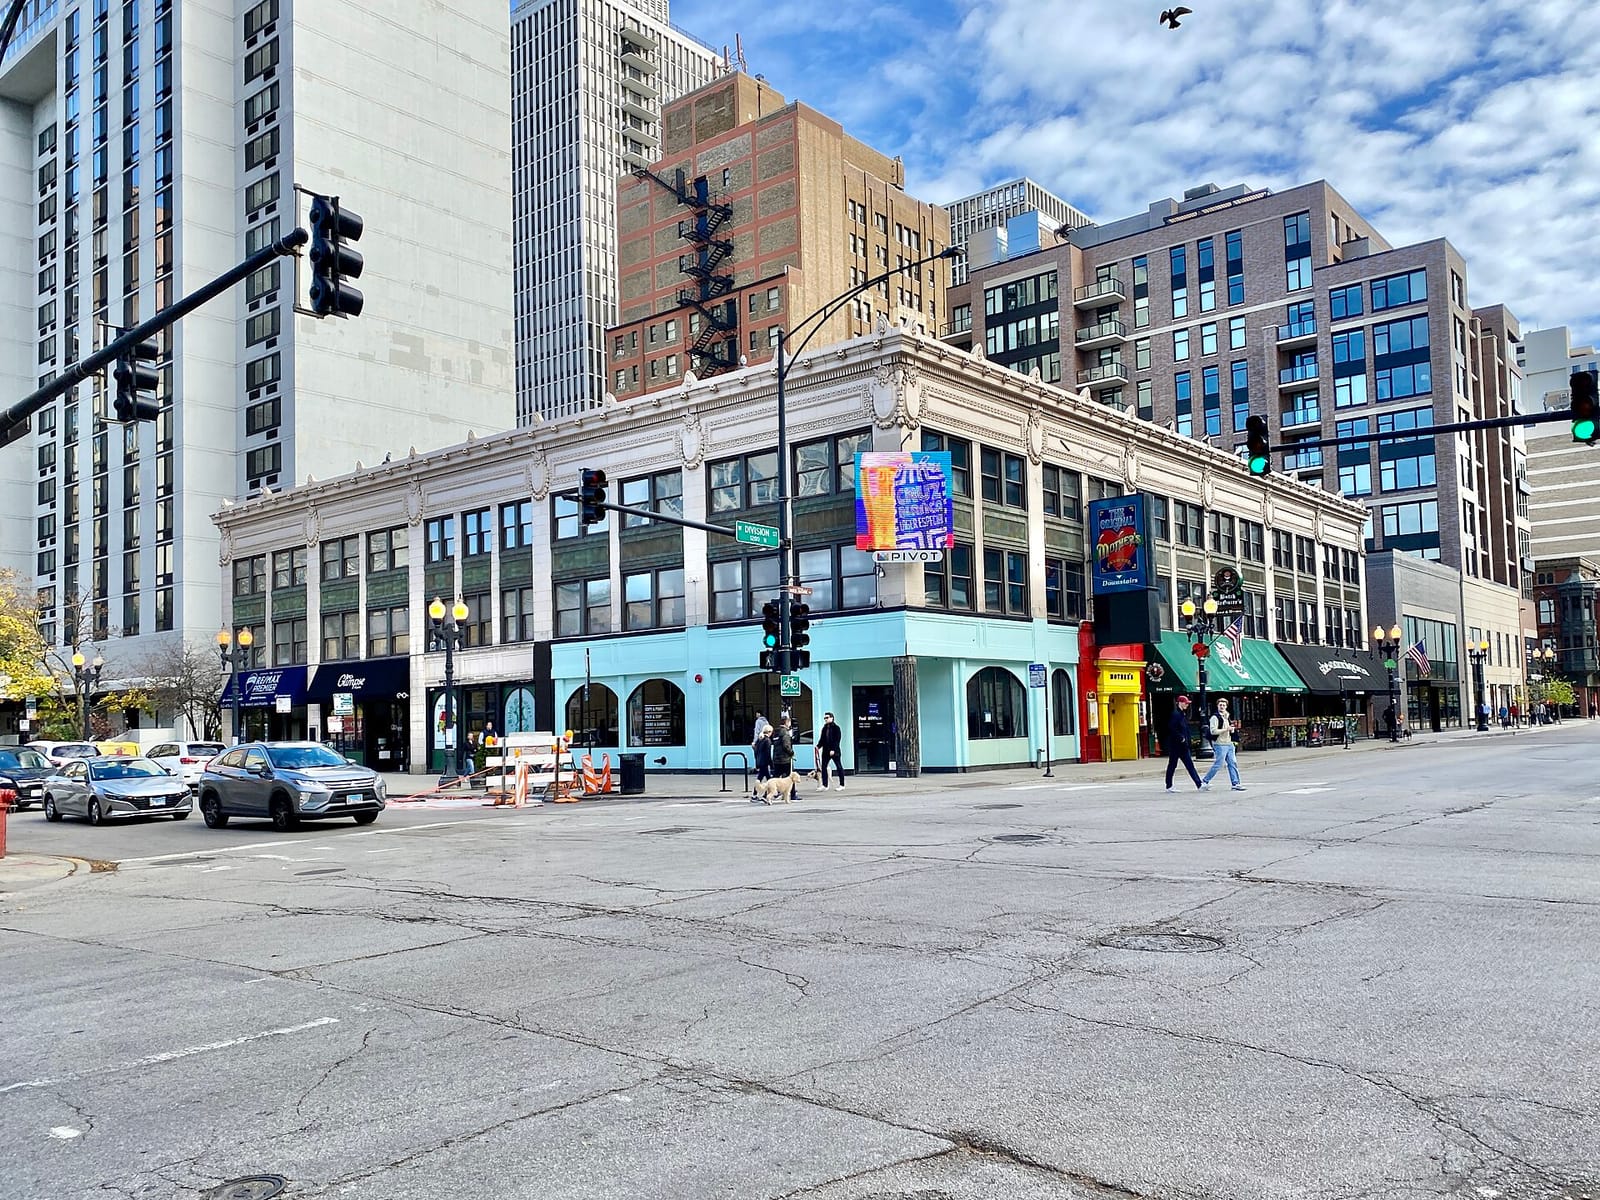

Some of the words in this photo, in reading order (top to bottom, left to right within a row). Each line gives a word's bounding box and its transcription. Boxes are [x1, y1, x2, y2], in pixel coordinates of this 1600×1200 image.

[744, 525, 770, 537] DIVISION
[1096, 533, 1141, 560] MOTHER'S
[891, 552, 938, 561] PIVOT
[1102, 578, 1138, 587] Downstairs
[255, 674, 282, 685] RE/MAX
[252, 683, 278, 692] PREMIER
